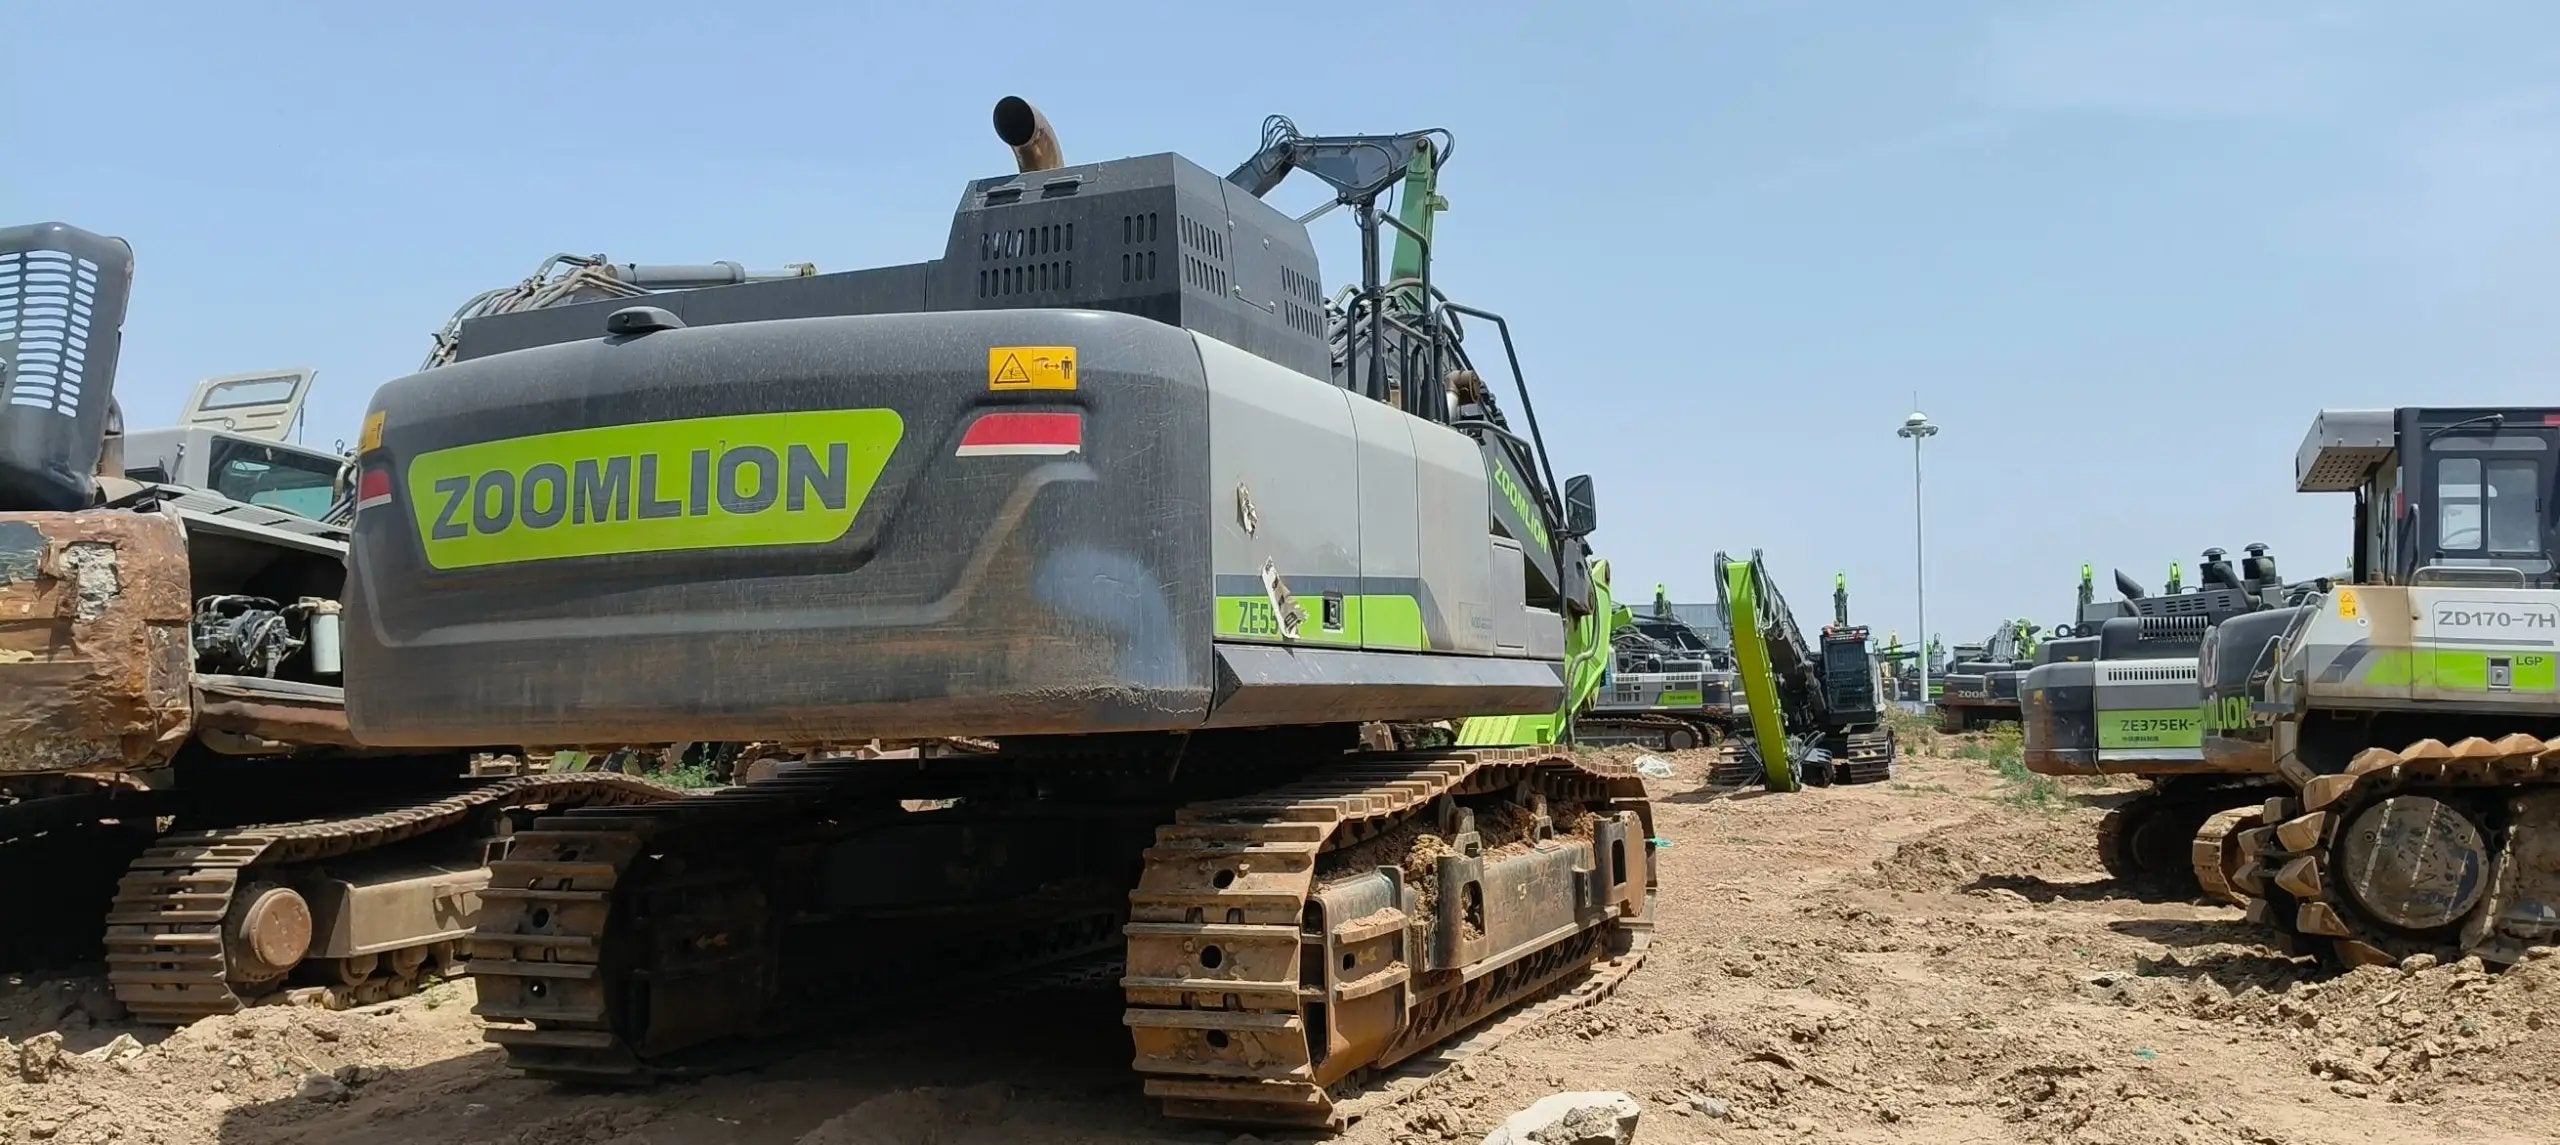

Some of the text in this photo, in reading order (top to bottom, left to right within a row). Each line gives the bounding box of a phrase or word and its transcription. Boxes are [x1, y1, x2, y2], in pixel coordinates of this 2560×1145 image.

[431, 443, 848, 540] ZOOMLION
[1493, 457, 1548, 554] ZOOMLION
[2438, 611, 2556, 628] ZD170-7H
[2515, 655, 2543, 666] LGP
